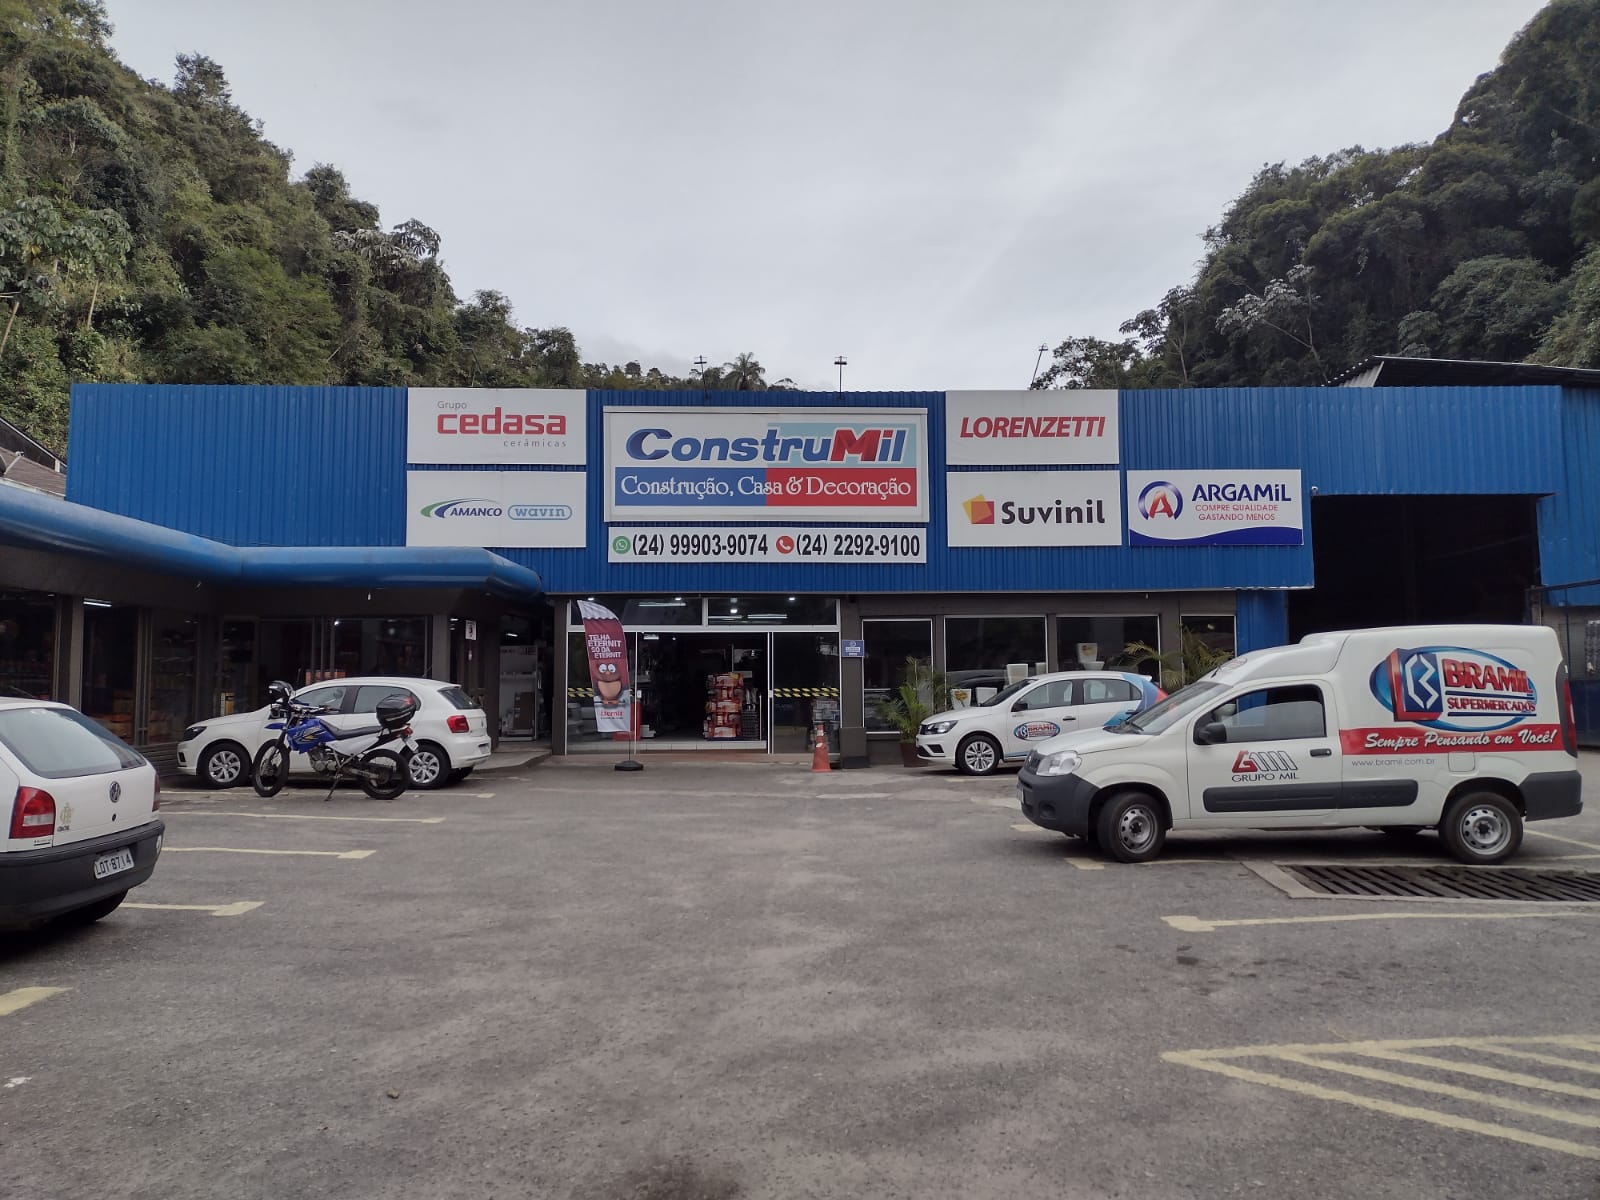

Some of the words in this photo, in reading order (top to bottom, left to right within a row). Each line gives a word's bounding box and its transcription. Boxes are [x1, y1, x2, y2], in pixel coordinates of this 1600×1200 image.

[437, 401, 467, 410] Grupo
[437, 407, 566, 435] cedasa
[960, 416, 1105, 438] LORENZETTI
[504, 439, 566, 447] cerâmicas
[626, 428, 906, 461] ConstruMil
[620, 475, 734, 500] Construção,
[737, 476, 782, 495] Casa
[786, 476, 803, 494] &
[806, 476, 911, 500] Decoração
[450, 507, 502, 517] AMANCO
[515, 508, 565, 517] wavin
[1002, 499, 1105, 524] Suvinil
[633, 534, 664, 557] (24)
[670, 534, 768, 556] 99903-9074
[796, 534, 827, 557] (24)
[833, 534, 920, 557] 2292-9100
[1442, 659, 1533, 693] BRAMIL
[1447, 697, 1535, 712] SUPERMERCADOS
[1364, 733, 1418, 751] Sempre
[1424, 731, 1490, 747] Pensando
[1494, 735, 1513, 744] em
[1517, 729, 1557, 744] Você!
[1351, 757, 1435, 767] www.bramil.com.br
[1232, 773, 1275, 782] GRUPO
[1280, 772, 1299, 780] MIL
